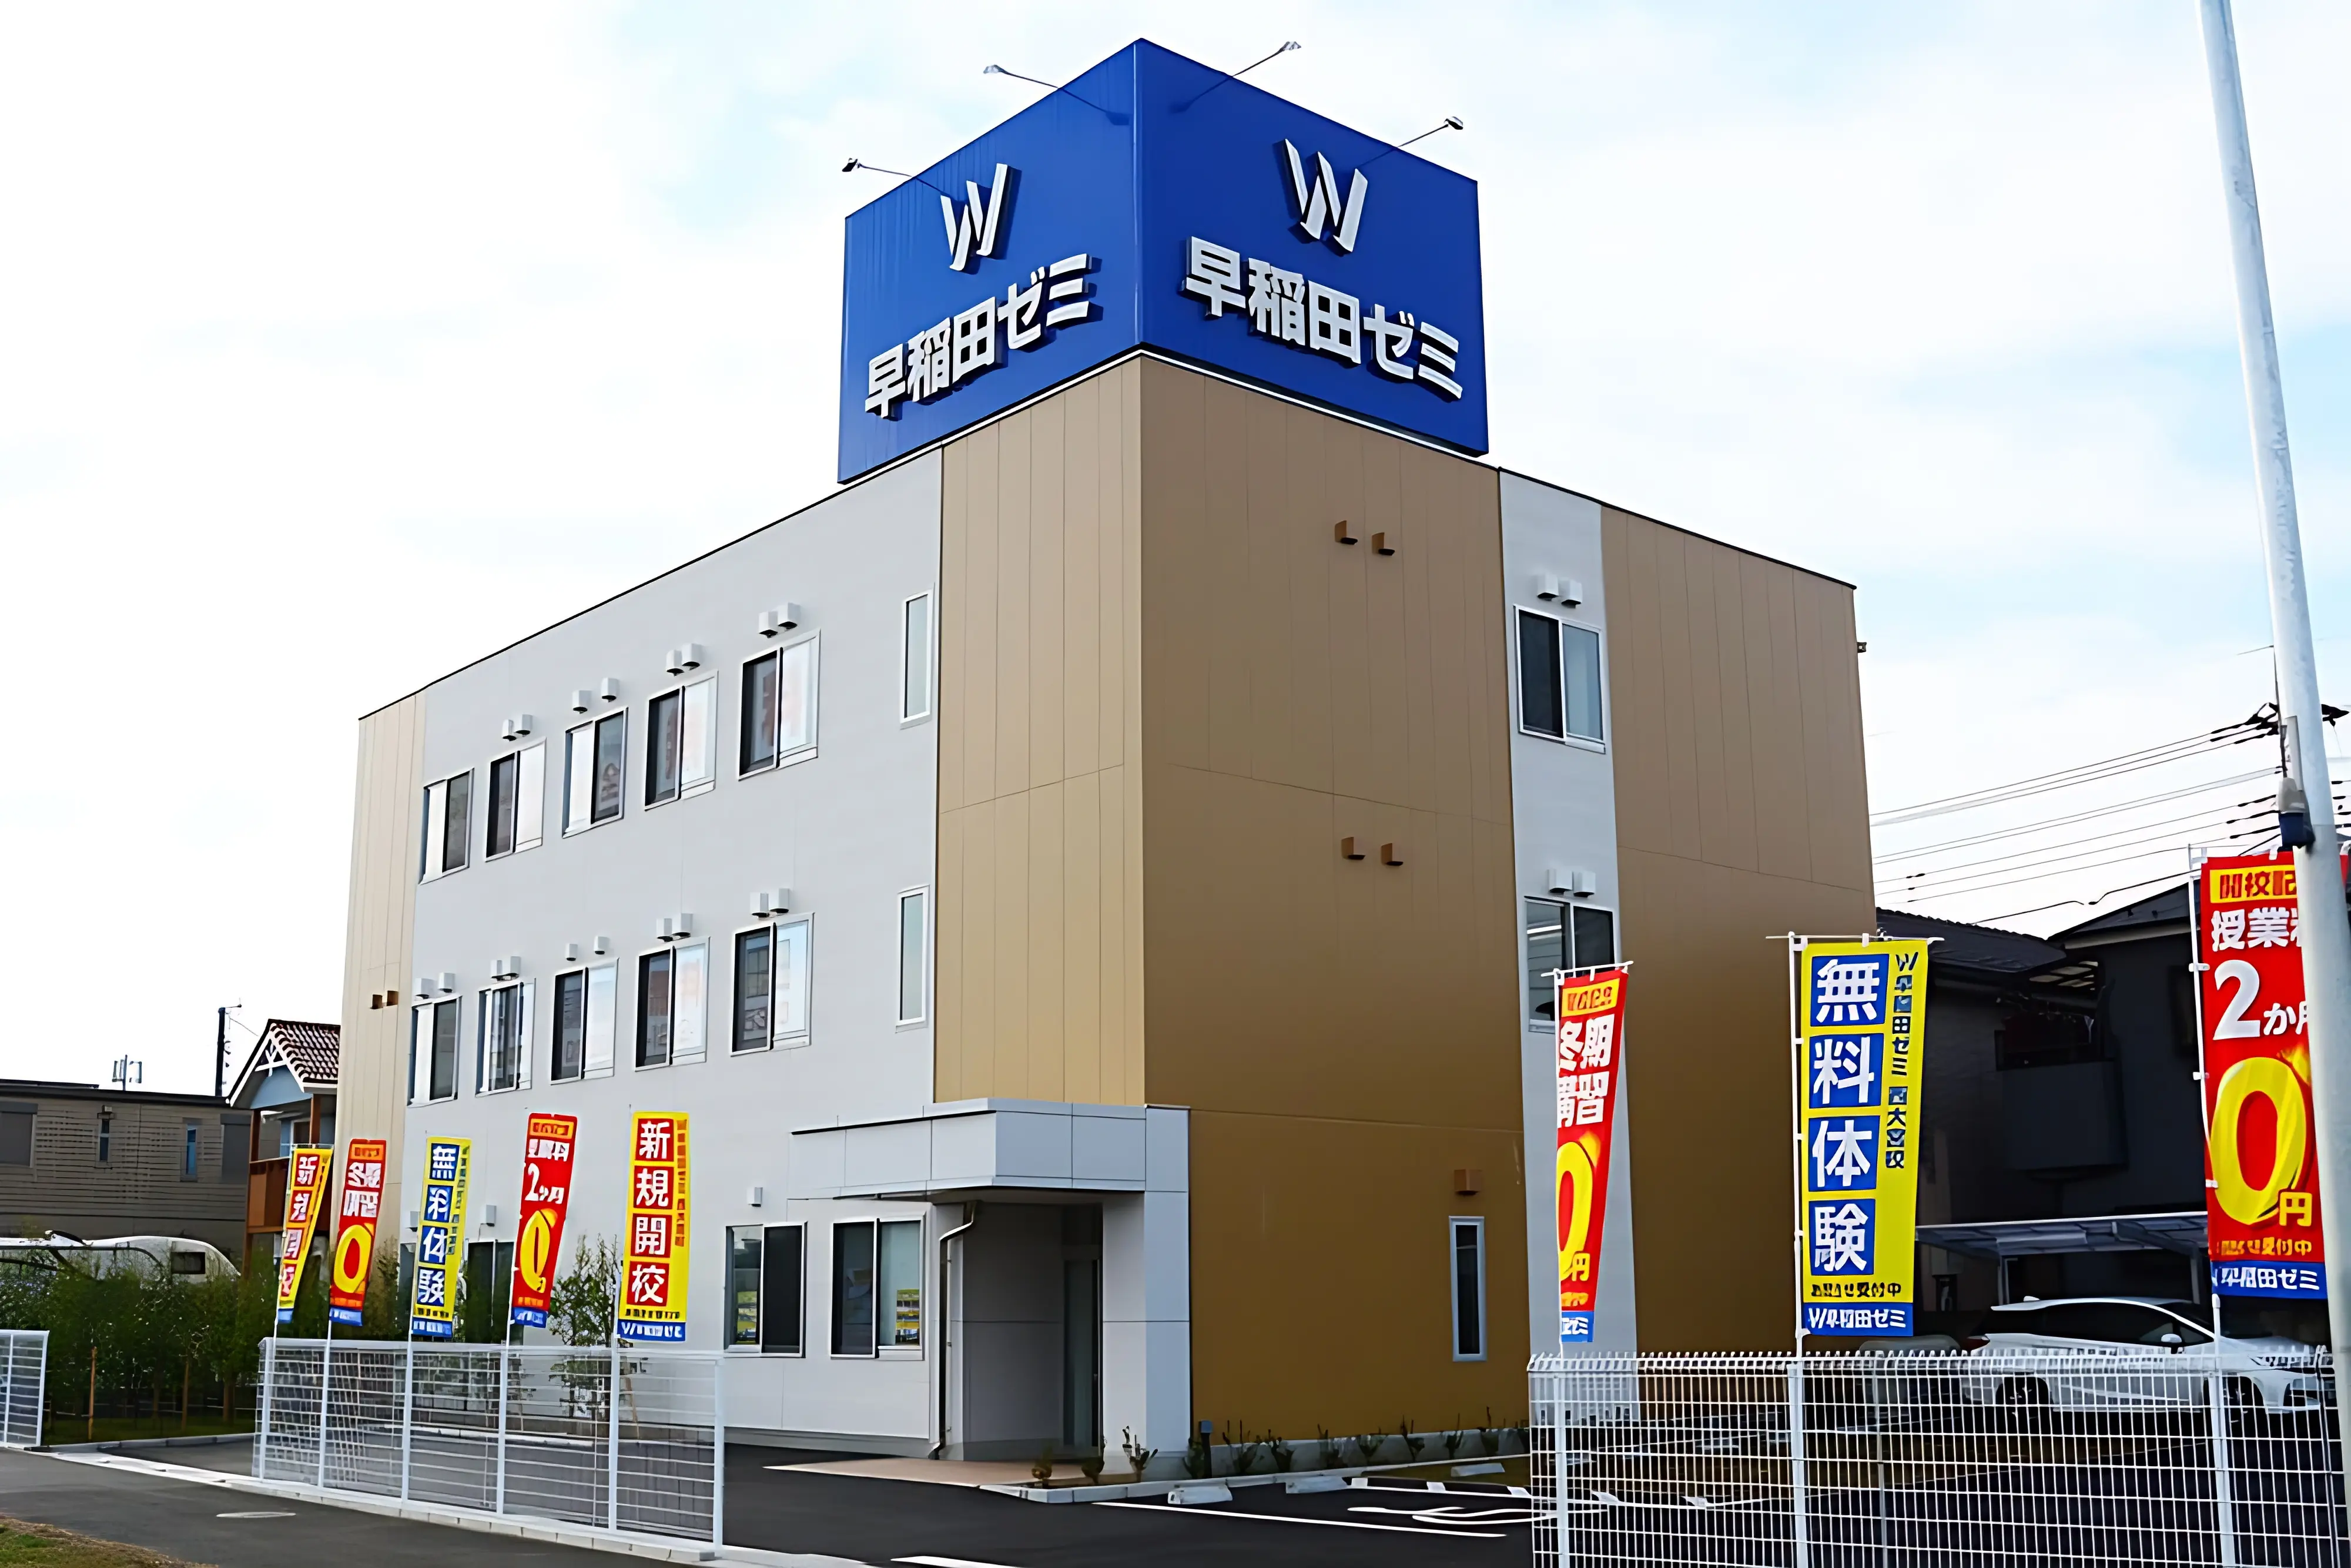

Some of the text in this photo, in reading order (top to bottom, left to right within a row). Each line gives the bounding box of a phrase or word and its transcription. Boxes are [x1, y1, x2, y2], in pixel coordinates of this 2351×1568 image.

[865, 253, 1090, 418] 早稲田ゼミ
[1183, 236, 1463, 400] 早稲田ゼミ
[1812, 958, 1880, 1273] 無料体験
[631, 1120, 671, 1304] 新規開校
[2221, 1267, 2320, 1291] 早田ゼミ
[1826, 1308, 1906, 1328] 早田ゼミ
